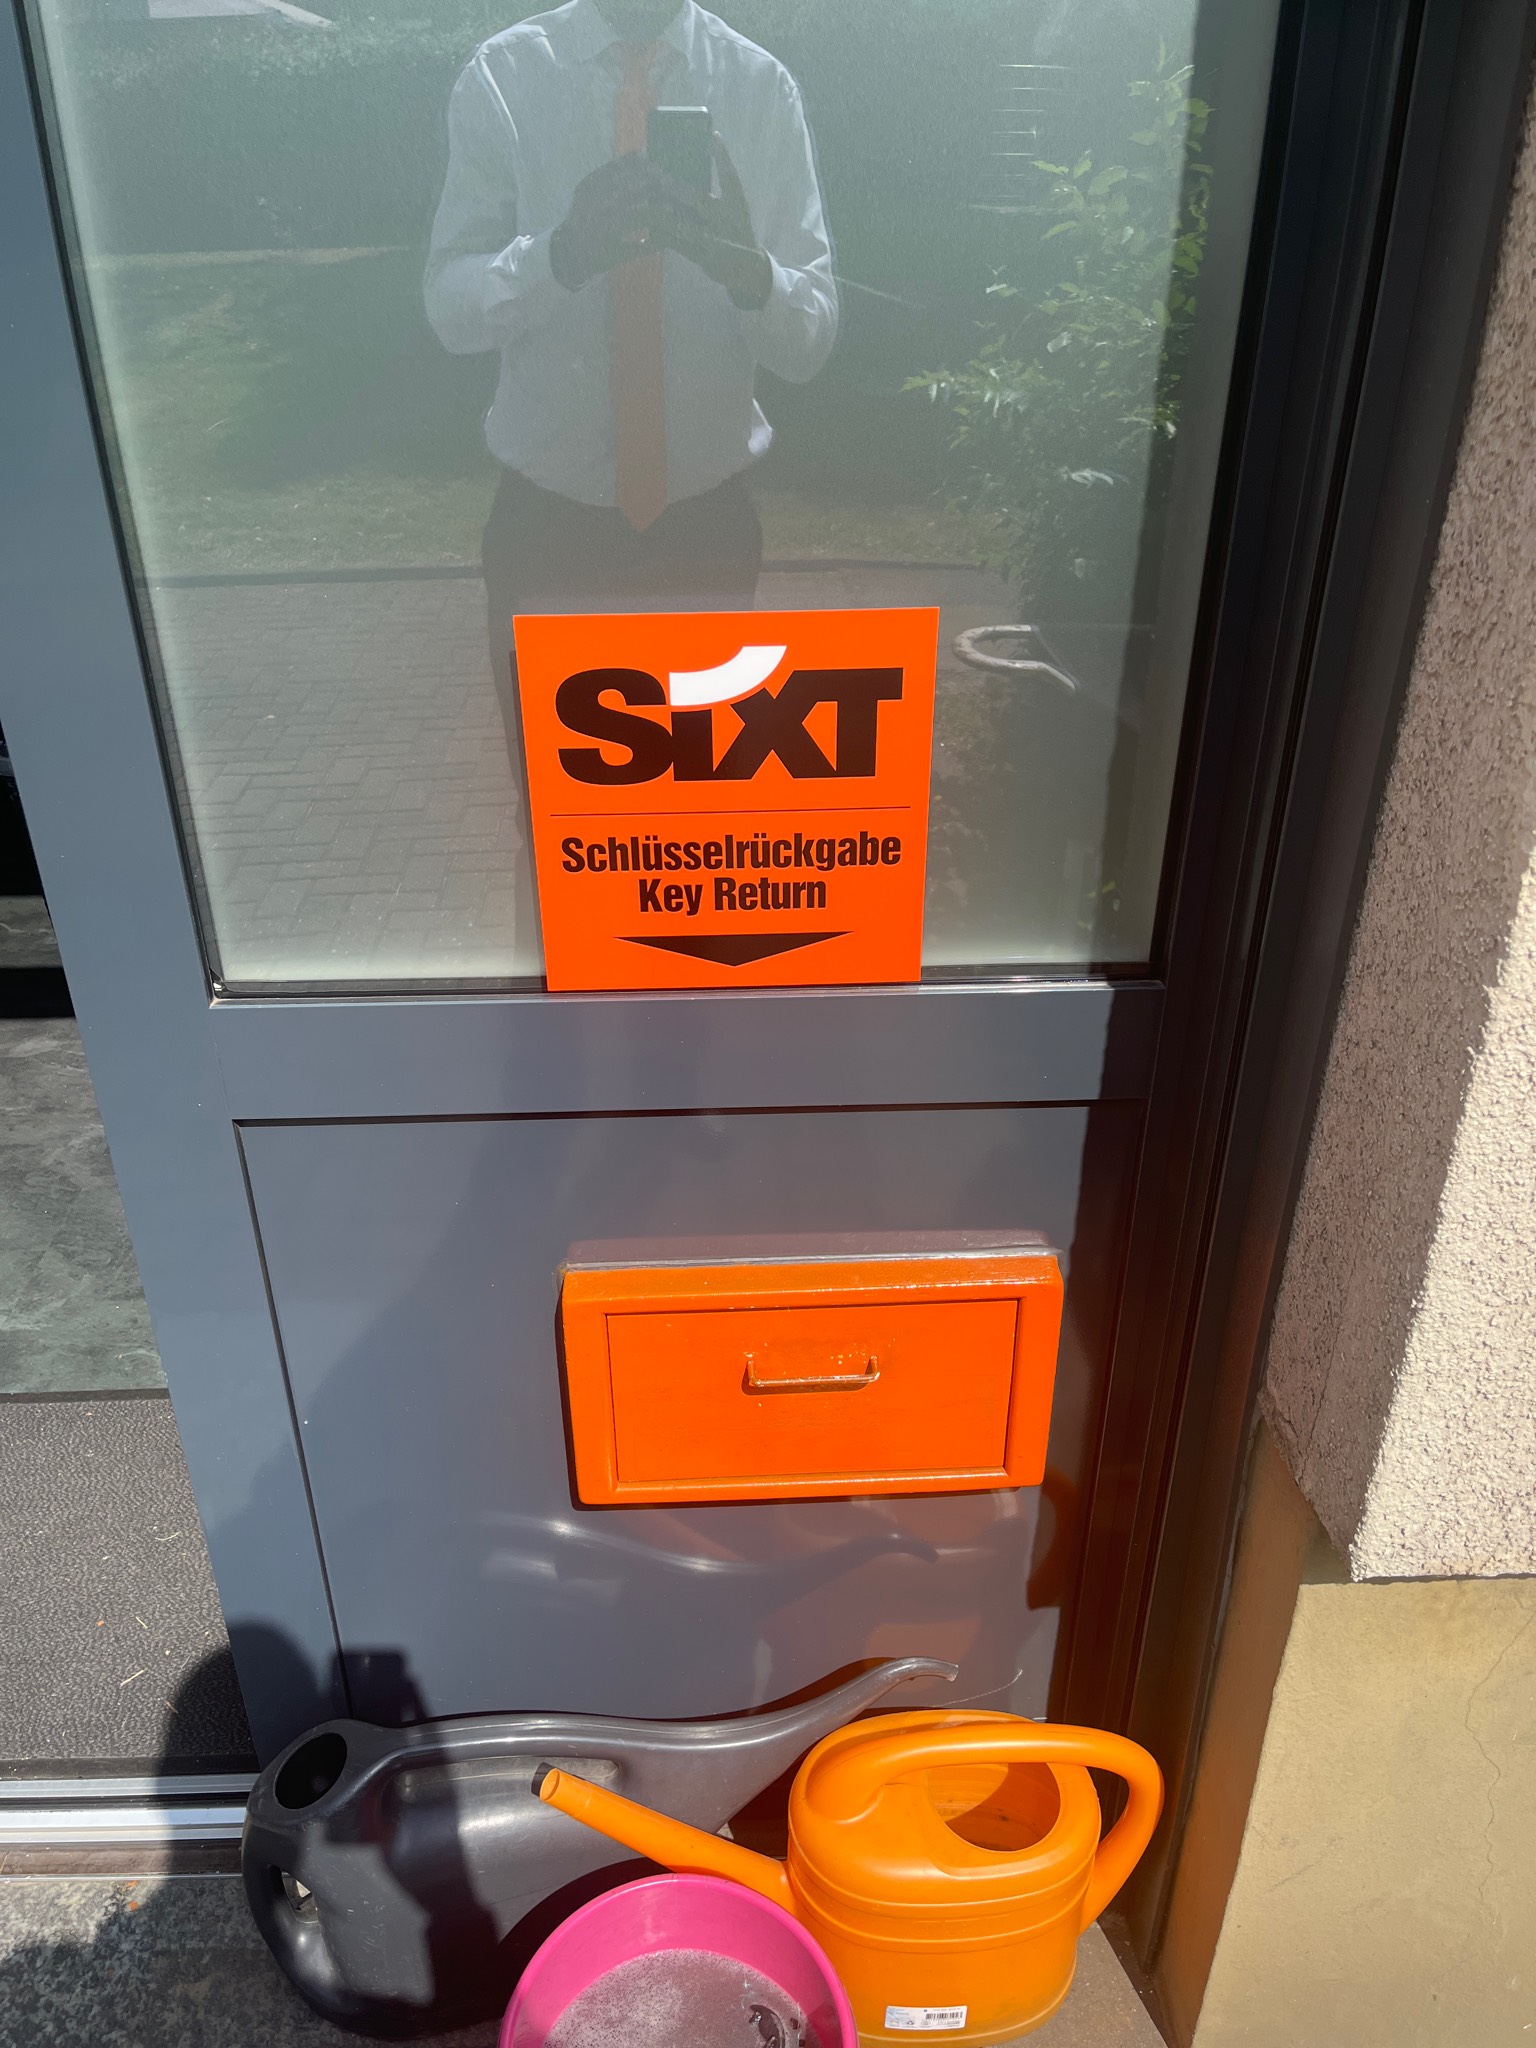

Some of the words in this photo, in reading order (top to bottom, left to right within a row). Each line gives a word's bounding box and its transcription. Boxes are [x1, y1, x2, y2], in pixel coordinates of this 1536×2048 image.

[561, 831, 902, 873] Schlüsselrückgabe
[638, 878, 704, 917] Key
[713, 876, 827, 911] Return
